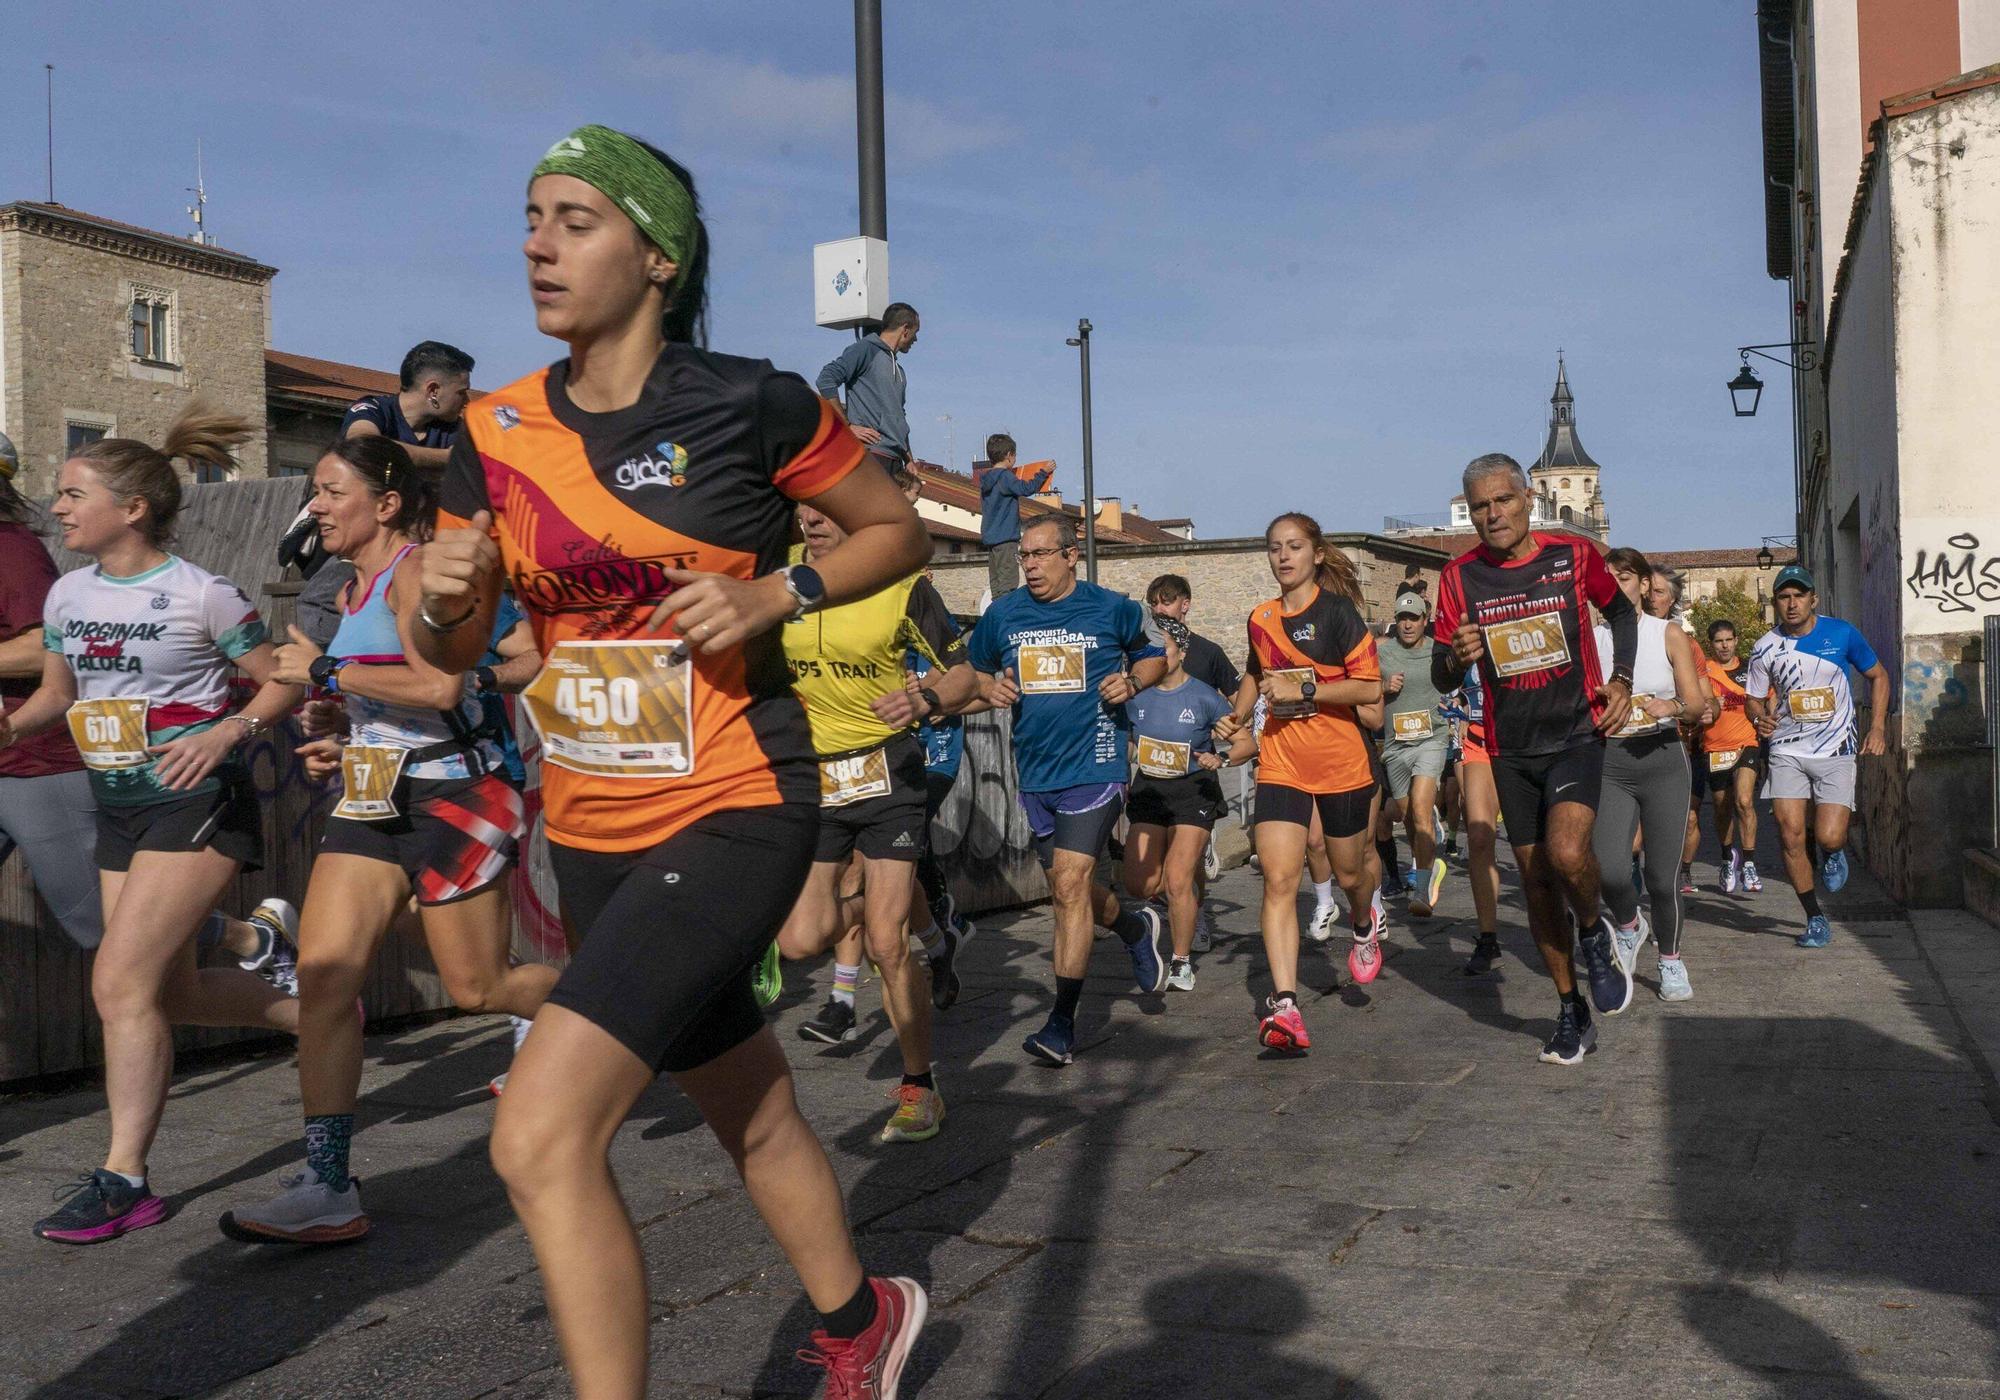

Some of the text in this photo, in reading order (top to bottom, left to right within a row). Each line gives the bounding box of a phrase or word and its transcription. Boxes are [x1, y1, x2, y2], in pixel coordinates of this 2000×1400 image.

[1478, 595, 1567, 625] AZKOITIAZPEITIA
[1018, 628, 1067, 640] CONQUISTA
[1020, 632, 1084, 648] ALMENDRA
[1508, 629, 1546, 655] 600
[1037, 656, 1066, 675] 267
[555, 677, 639, 727] 450
[1802, 696, 1824, 710] 667
[85, 715, 121, 743] 670
[1403, 719, 1421, 730] 460
[1150, 749, 1175, 766] 443
[1719, 751, 1737, 763] 383
[354, 763, 373, 791] 57
